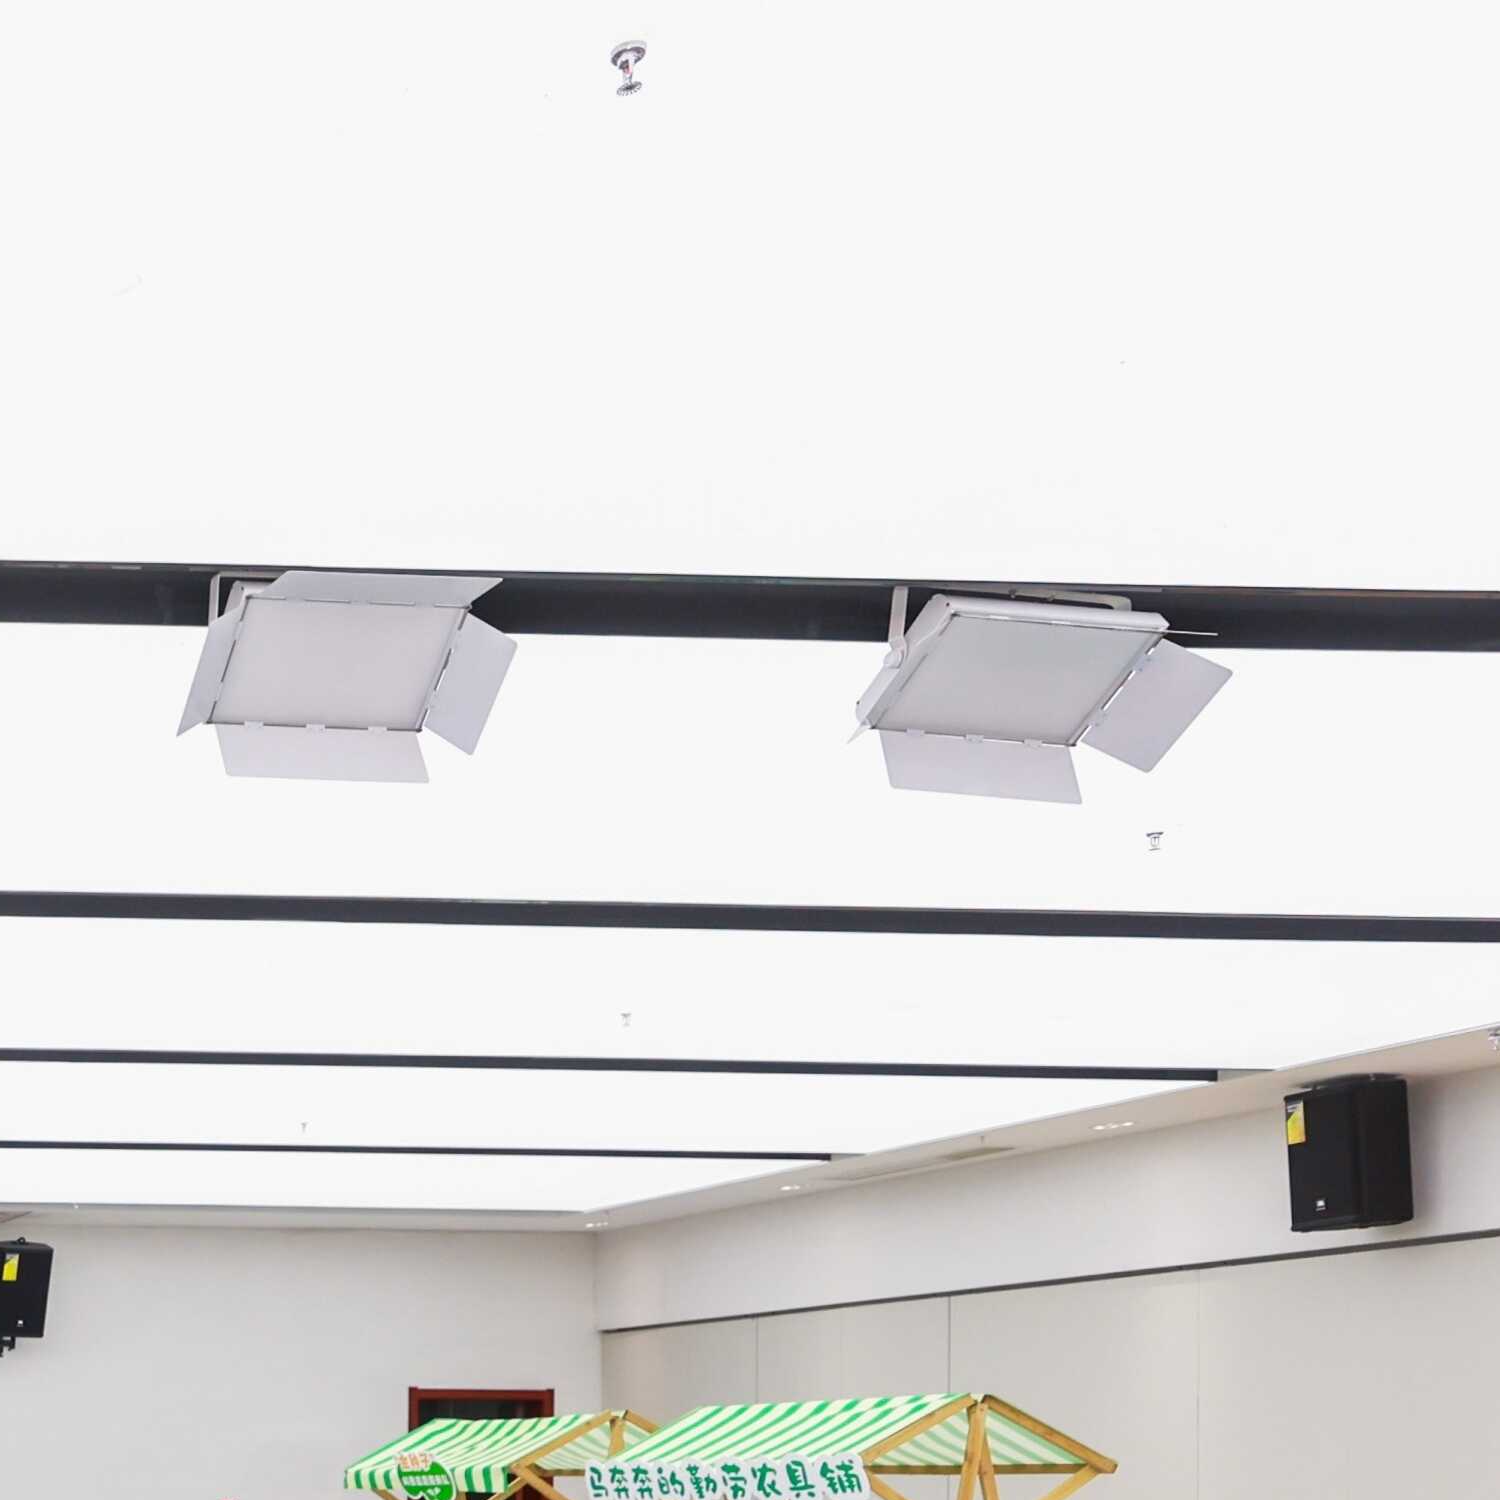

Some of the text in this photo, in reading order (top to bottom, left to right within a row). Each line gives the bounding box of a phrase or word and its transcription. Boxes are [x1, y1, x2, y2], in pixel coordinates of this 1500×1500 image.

[586, 1459, 864, 1500] 马奔奔的勤劳农具铺
